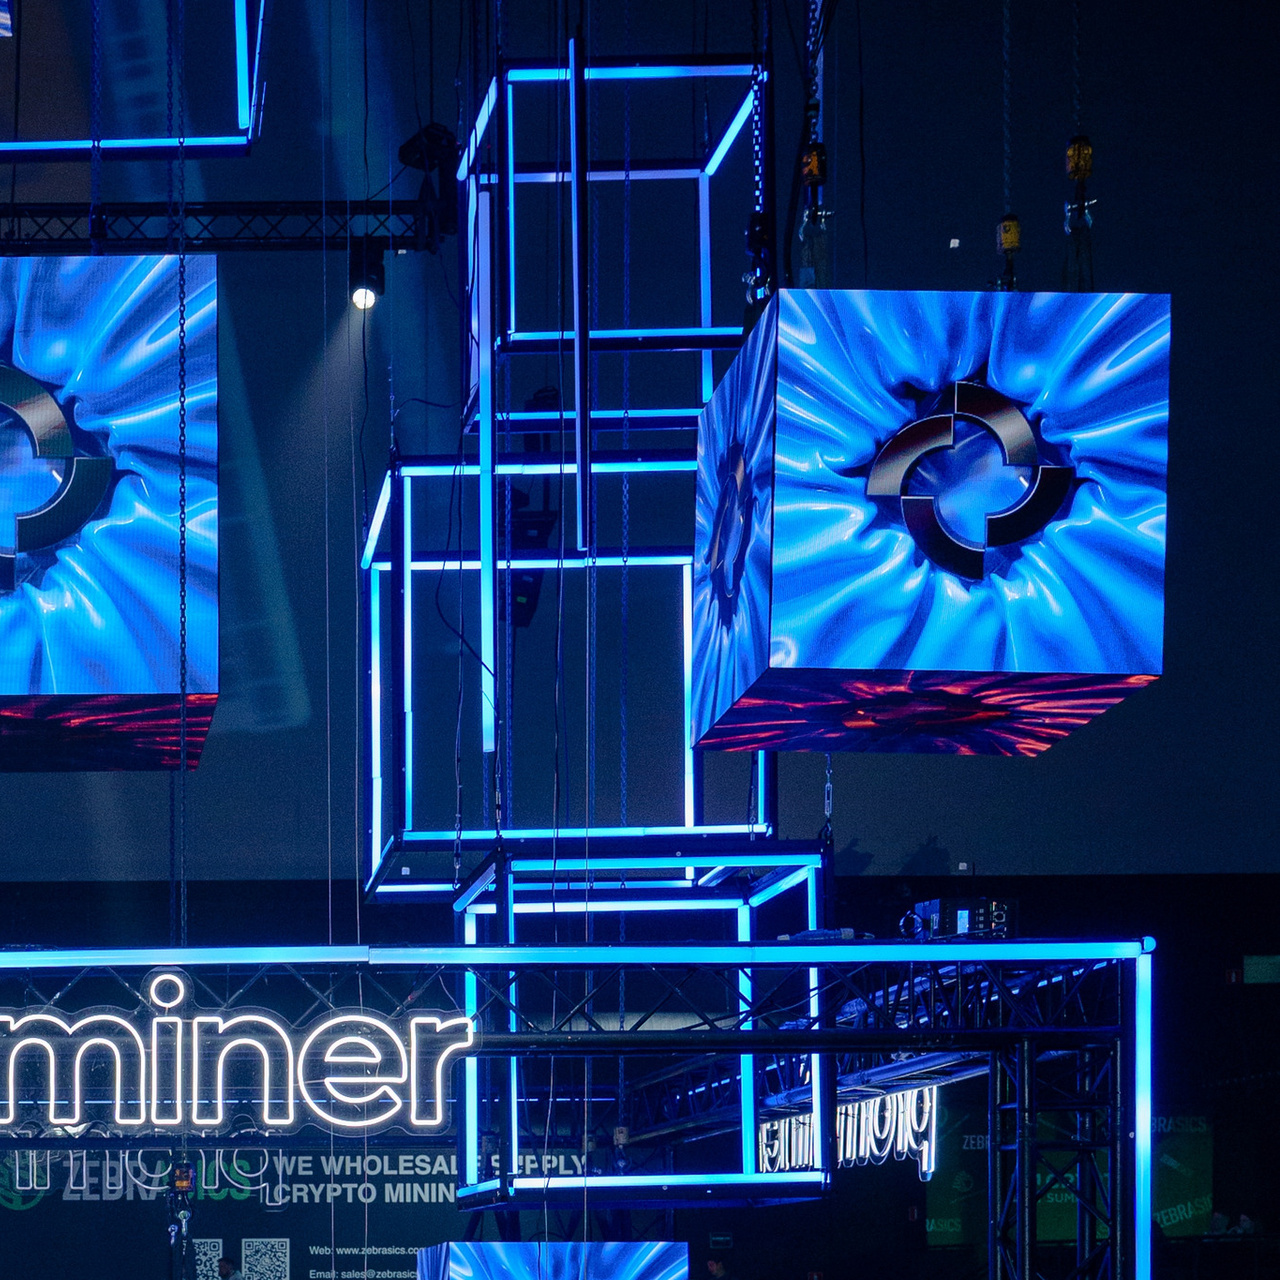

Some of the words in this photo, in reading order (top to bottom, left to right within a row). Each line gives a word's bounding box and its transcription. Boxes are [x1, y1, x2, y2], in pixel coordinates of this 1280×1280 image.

[274, 1155, 314, 1176] WE
[321, 1155, 480, 1176] WHOLESAL
[491, 1155, 588, 1176] SPPLY
[62, 1160, 251, 1201] ZEBRAICS
[274, 1183, 376, 1204] CRYPTO
[384, 1183, 459, 1204] MININ
[308, 1246, 333, 1256] Web:
[341, 1270, 418, 1280] sales@zebrasics
